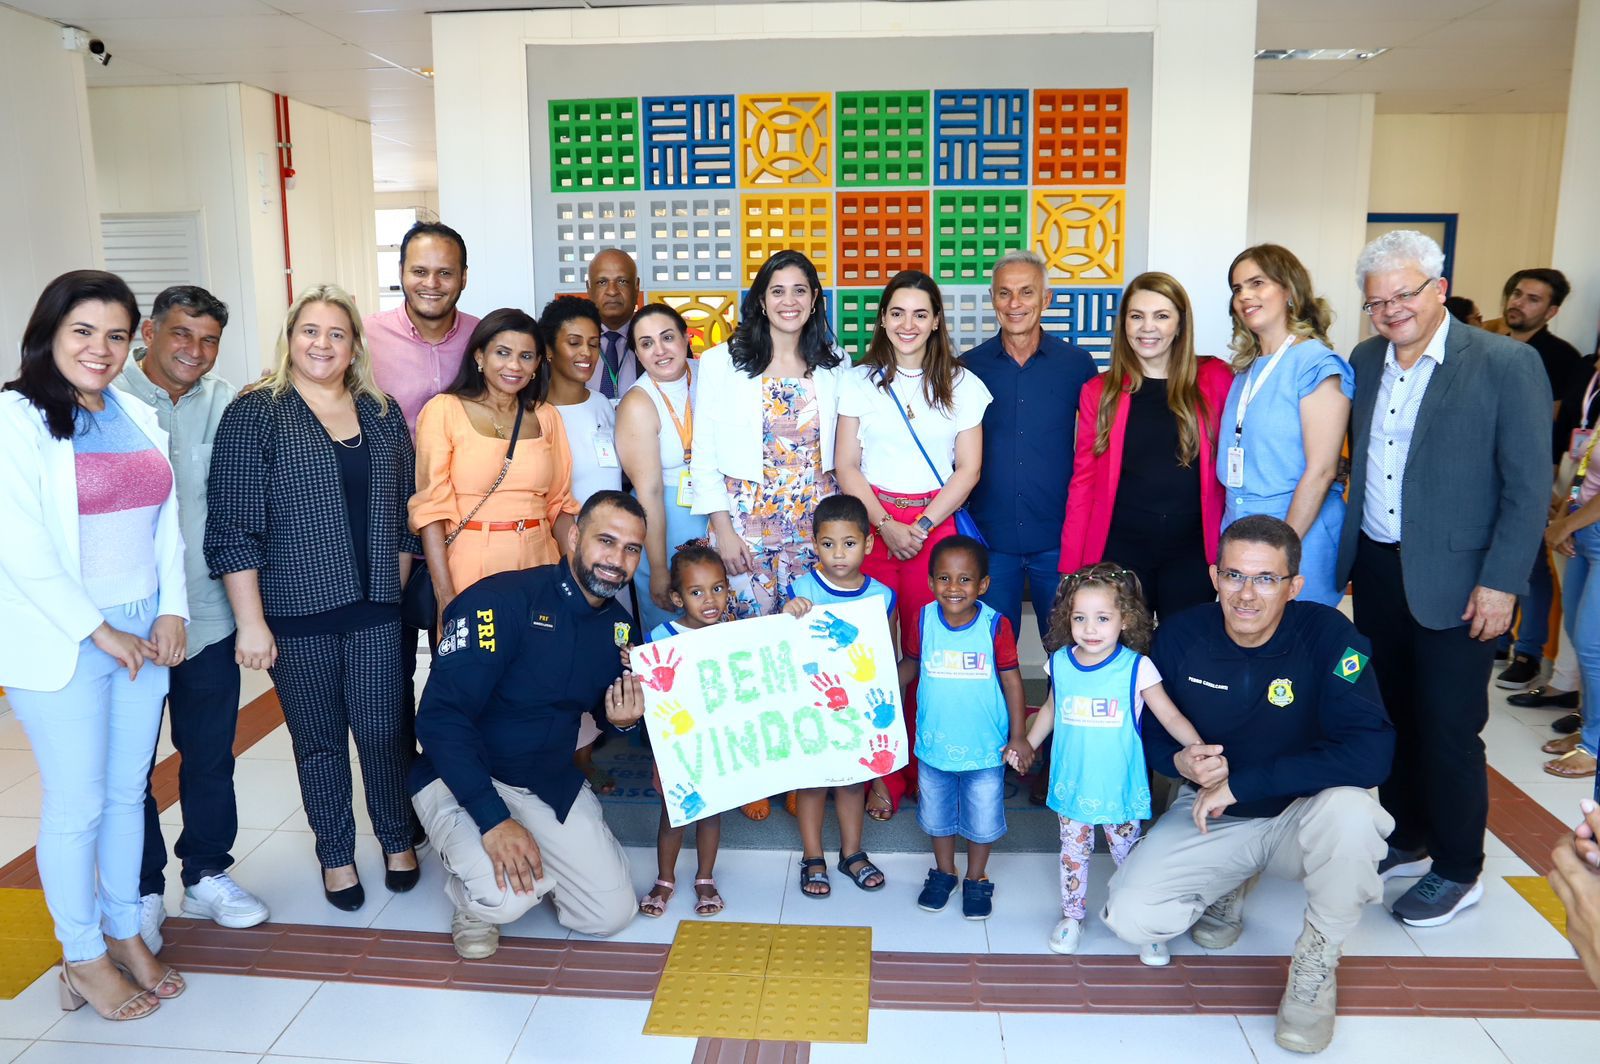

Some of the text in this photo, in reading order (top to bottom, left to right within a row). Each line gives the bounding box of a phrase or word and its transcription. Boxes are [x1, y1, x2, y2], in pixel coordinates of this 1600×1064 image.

[476, 608, 496, 653] PRF
[696, 640, 798, 713] BEM
[930, 650, 986, 670] CMEI
[1062, 697, 1119, 717] CMEI
[672, 706, 864, 785] VINDOS
